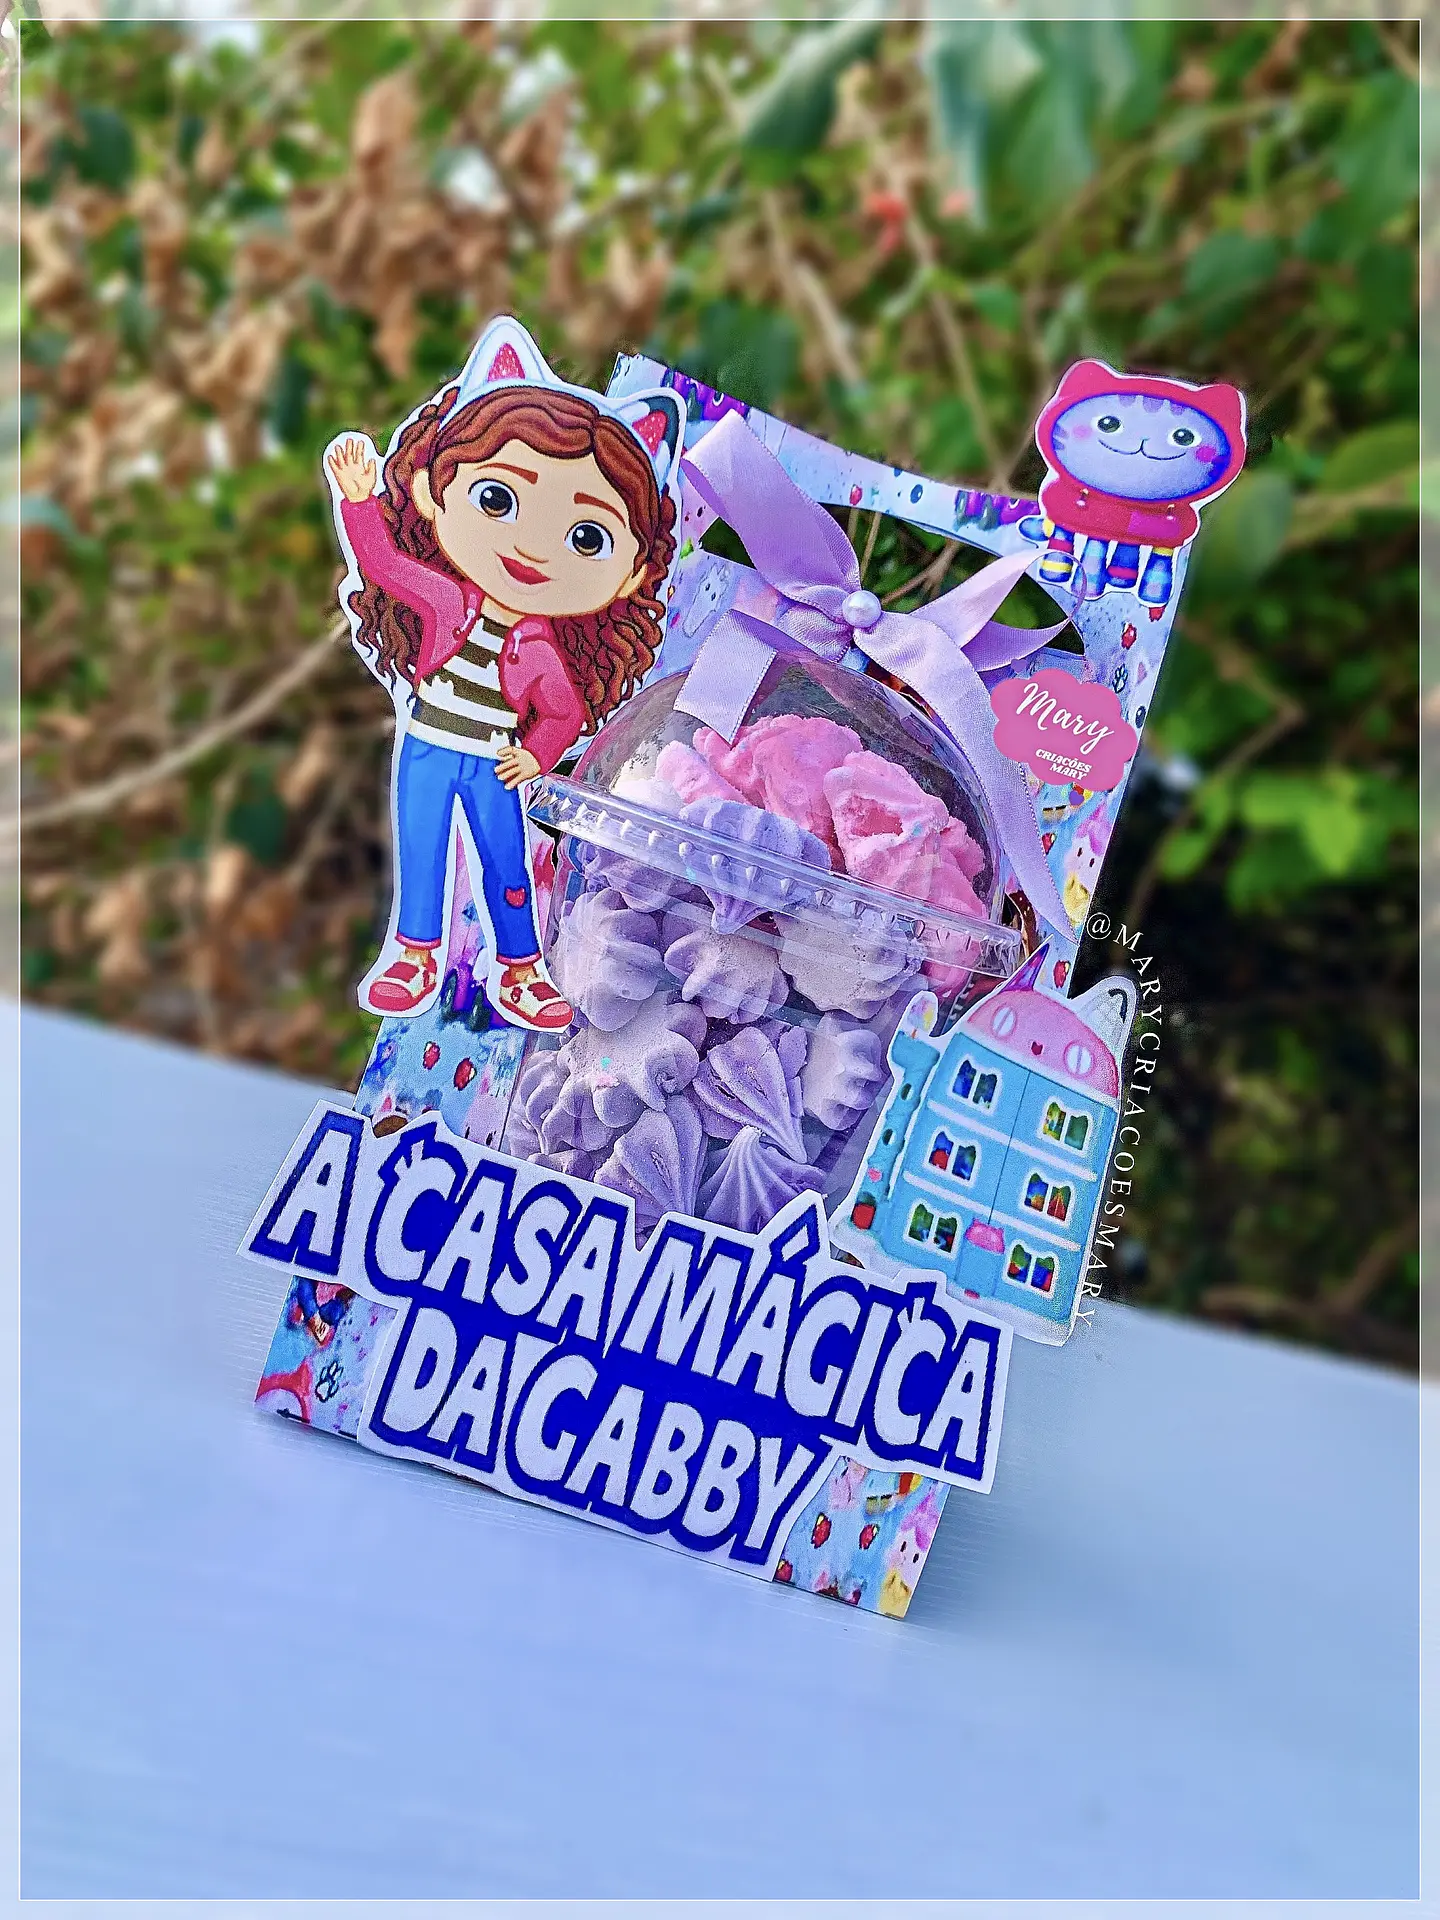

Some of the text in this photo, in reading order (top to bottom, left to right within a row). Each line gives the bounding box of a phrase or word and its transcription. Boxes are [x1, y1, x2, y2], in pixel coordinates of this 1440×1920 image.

[248, 1109, 1001, 1480] A CASA MÁGICA
[370, 1302, 834, 1566] DA GABBY
